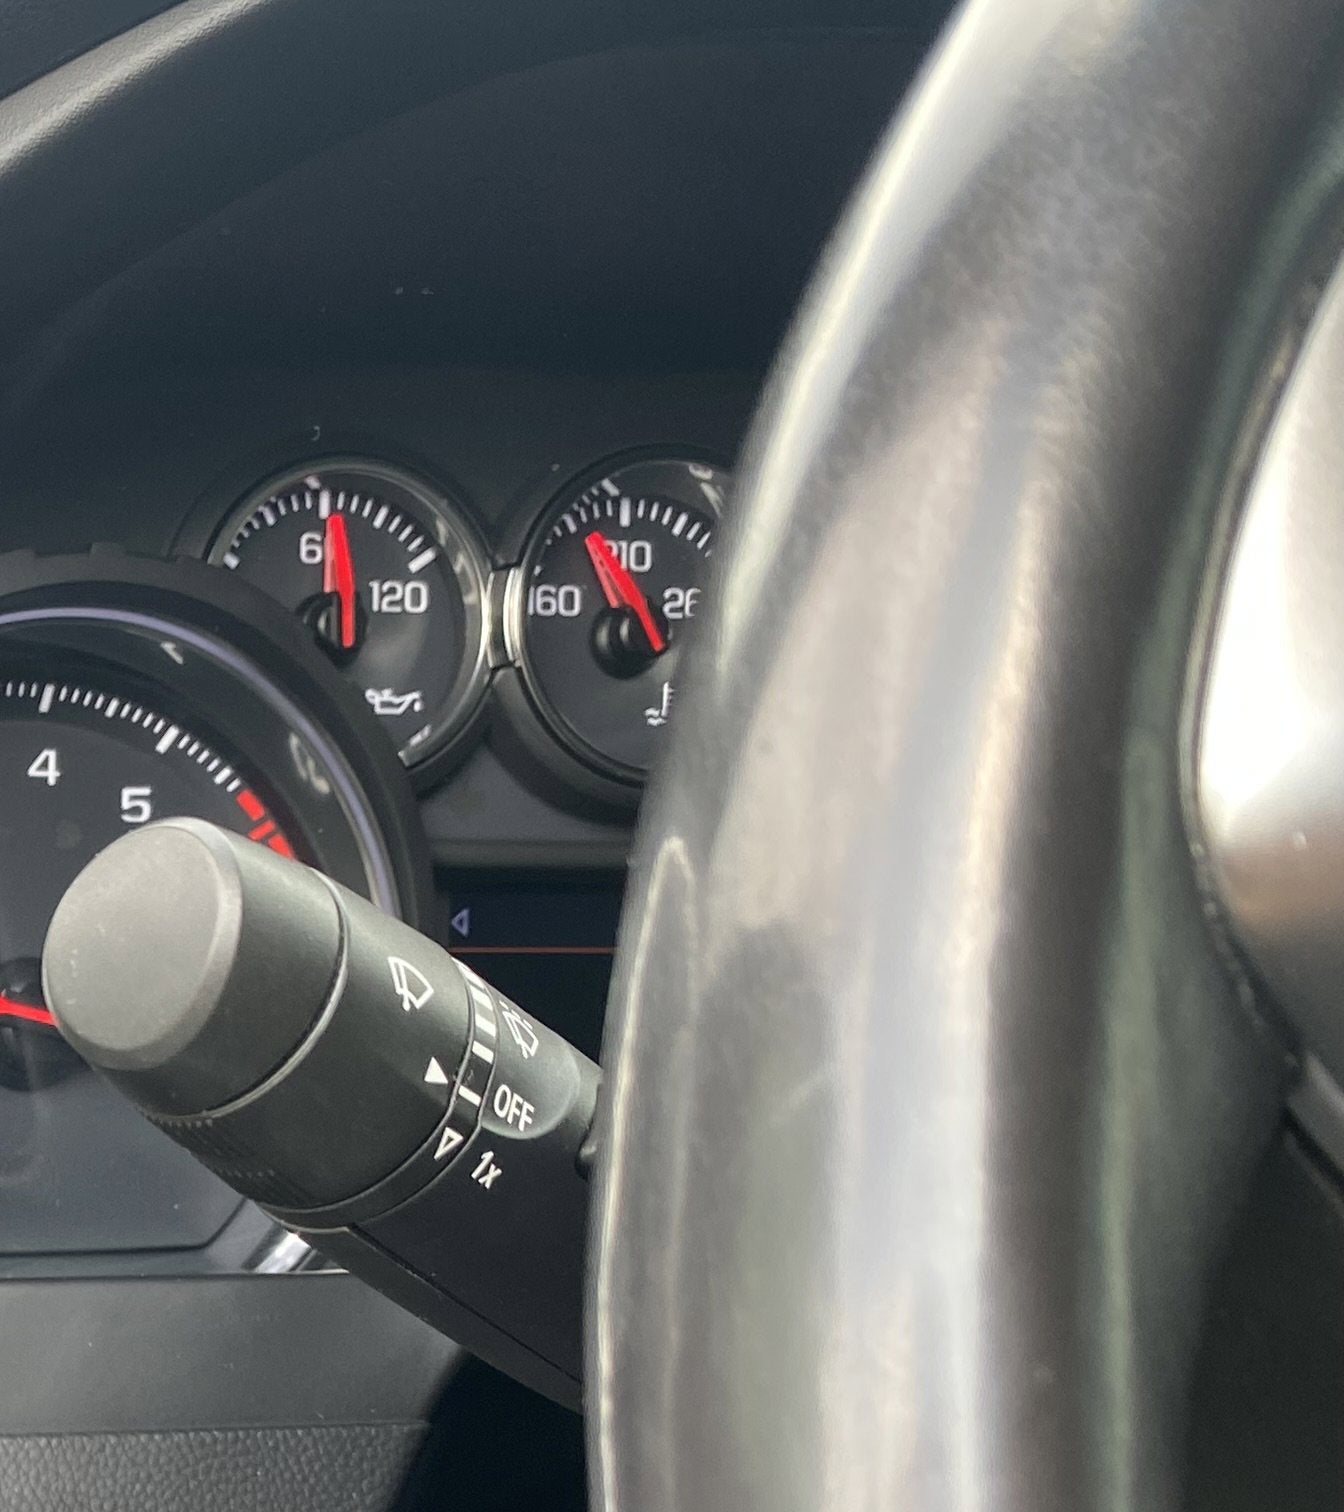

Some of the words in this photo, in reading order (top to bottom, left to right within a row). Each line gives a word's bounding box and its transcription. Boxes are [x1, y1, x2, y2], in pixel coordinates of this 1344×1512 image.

[368, 580, 429, 614] 120
[527, 584, 582, 617] 160
[27, 749, 61, 786] 4
[121, 786, 152, 823] 5
[493, 1084, 535, 1132] OFF
[470, 1150, 503, 1189] 1x
